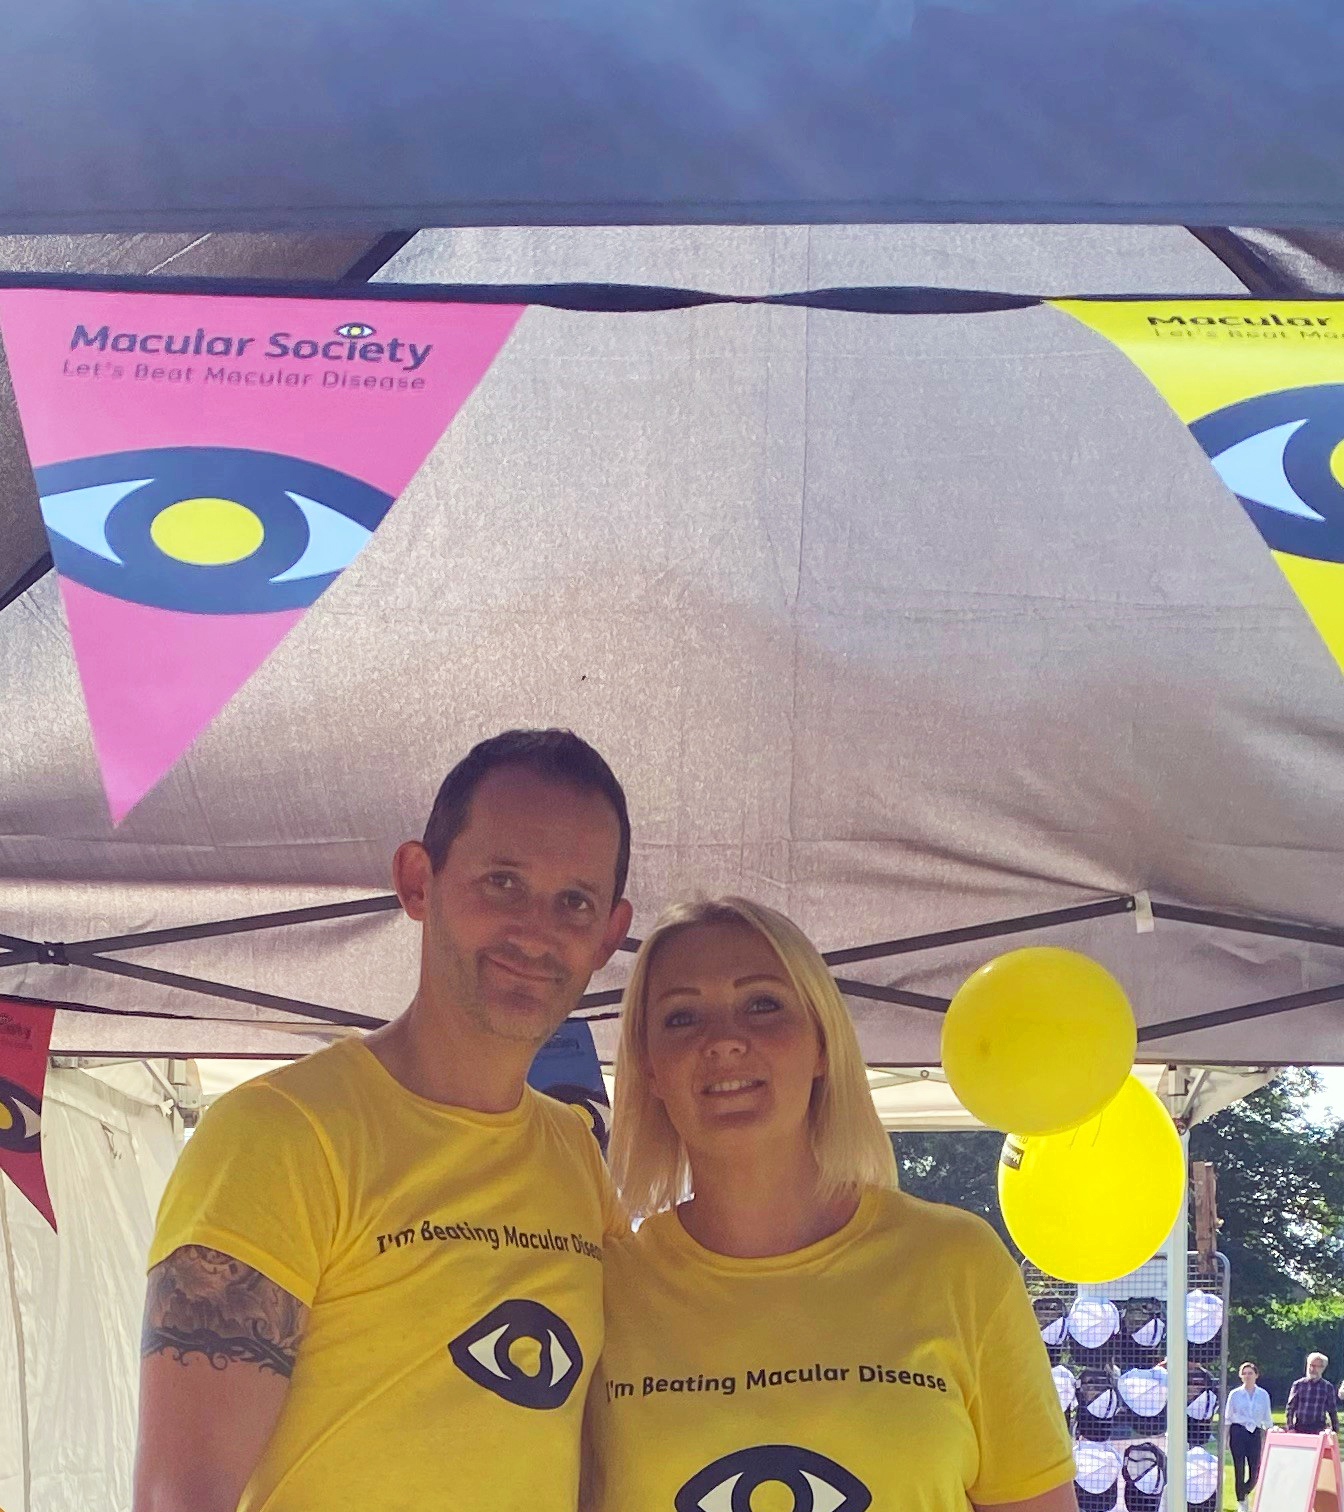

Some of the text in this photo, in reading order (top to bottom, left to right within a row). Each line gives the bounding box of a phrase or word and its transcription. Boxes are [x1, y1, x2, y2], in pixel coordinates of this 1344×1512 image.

[1147, 314, 1331, 327] Macular
[70, 324, 433, 371] Macular Society
[63, 359, 426, 392] Let's Beat Macular Disease
[376, 1227, 415, 1254] I'm
[420, 1220, 500, 1250] Beating
[502, 1225, 570, 1252] Macular
[606, 1363, 948, 1402] I'm Beating Macular Disease
